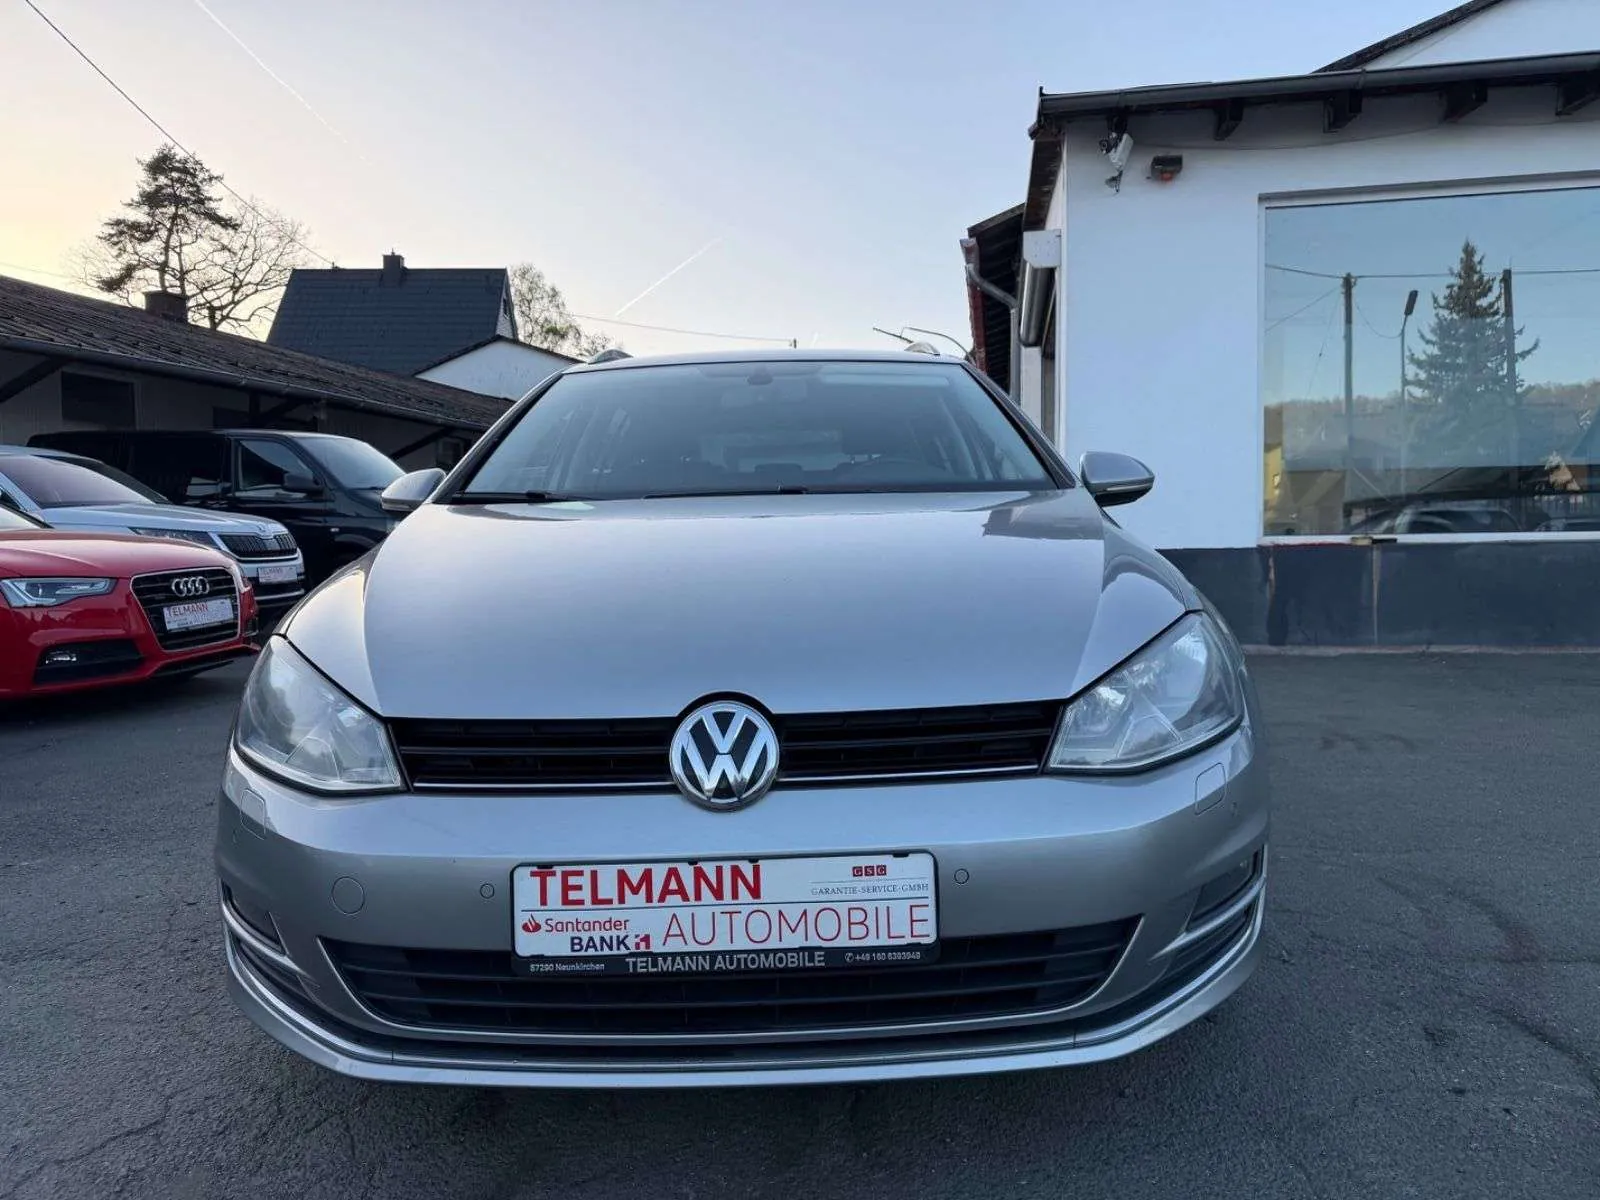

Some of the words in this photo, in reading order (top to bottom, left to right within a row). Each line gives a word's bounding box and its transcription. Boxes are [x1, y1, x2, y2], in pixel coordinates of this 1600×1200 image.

[529, 864, 762, 906] TELMANN
[545, 917, 630, 934] Santander
[662, 904, 931, 947] AUTOMOBILE
[570, 935, 631, 953] BANK
[626, 955, 709, 973] TELMANN
[713, 952, 825, 970] AUTOMOBILE
